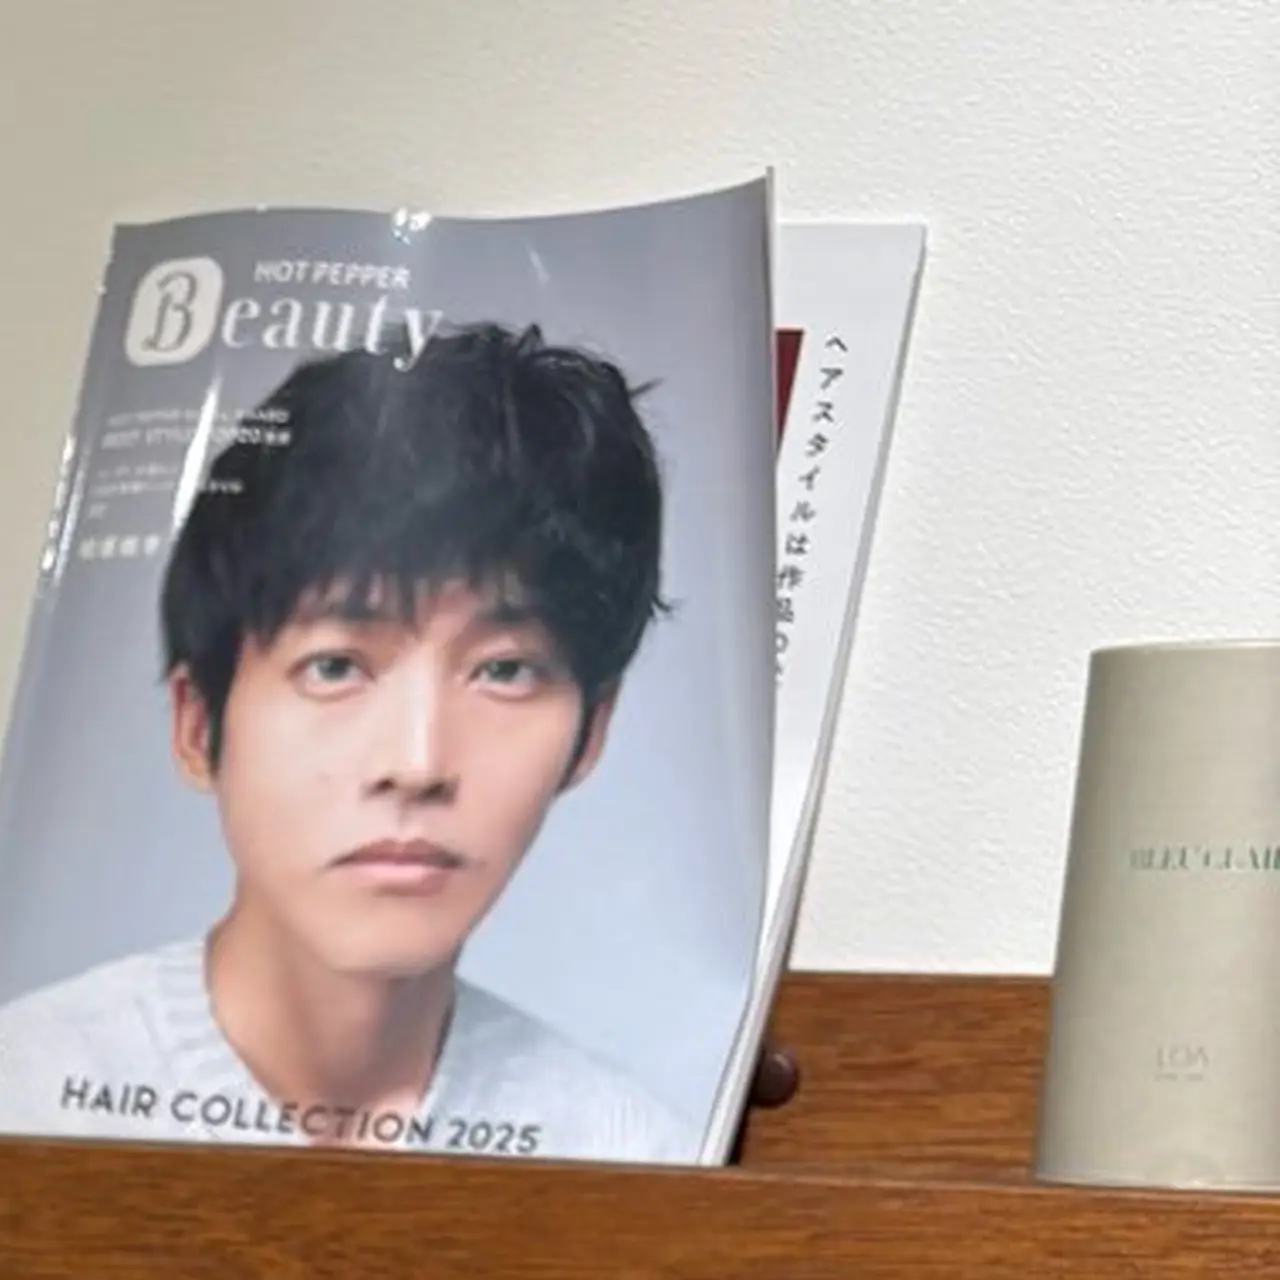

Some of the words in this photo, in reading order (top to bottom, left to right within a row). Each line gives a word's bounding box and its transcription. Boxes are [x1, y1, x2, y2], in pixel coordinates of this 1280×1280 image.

[254, 260, 308, 284] HOT
[310, 262, 412, 290] PEPPER
[138, 268, 443, 373] Beauty
[59, 1074, 159, 1118] HAIR
[169, 1090, 436, 1145] COLLECTION
[446, 1117, 543, 1155] 2025
